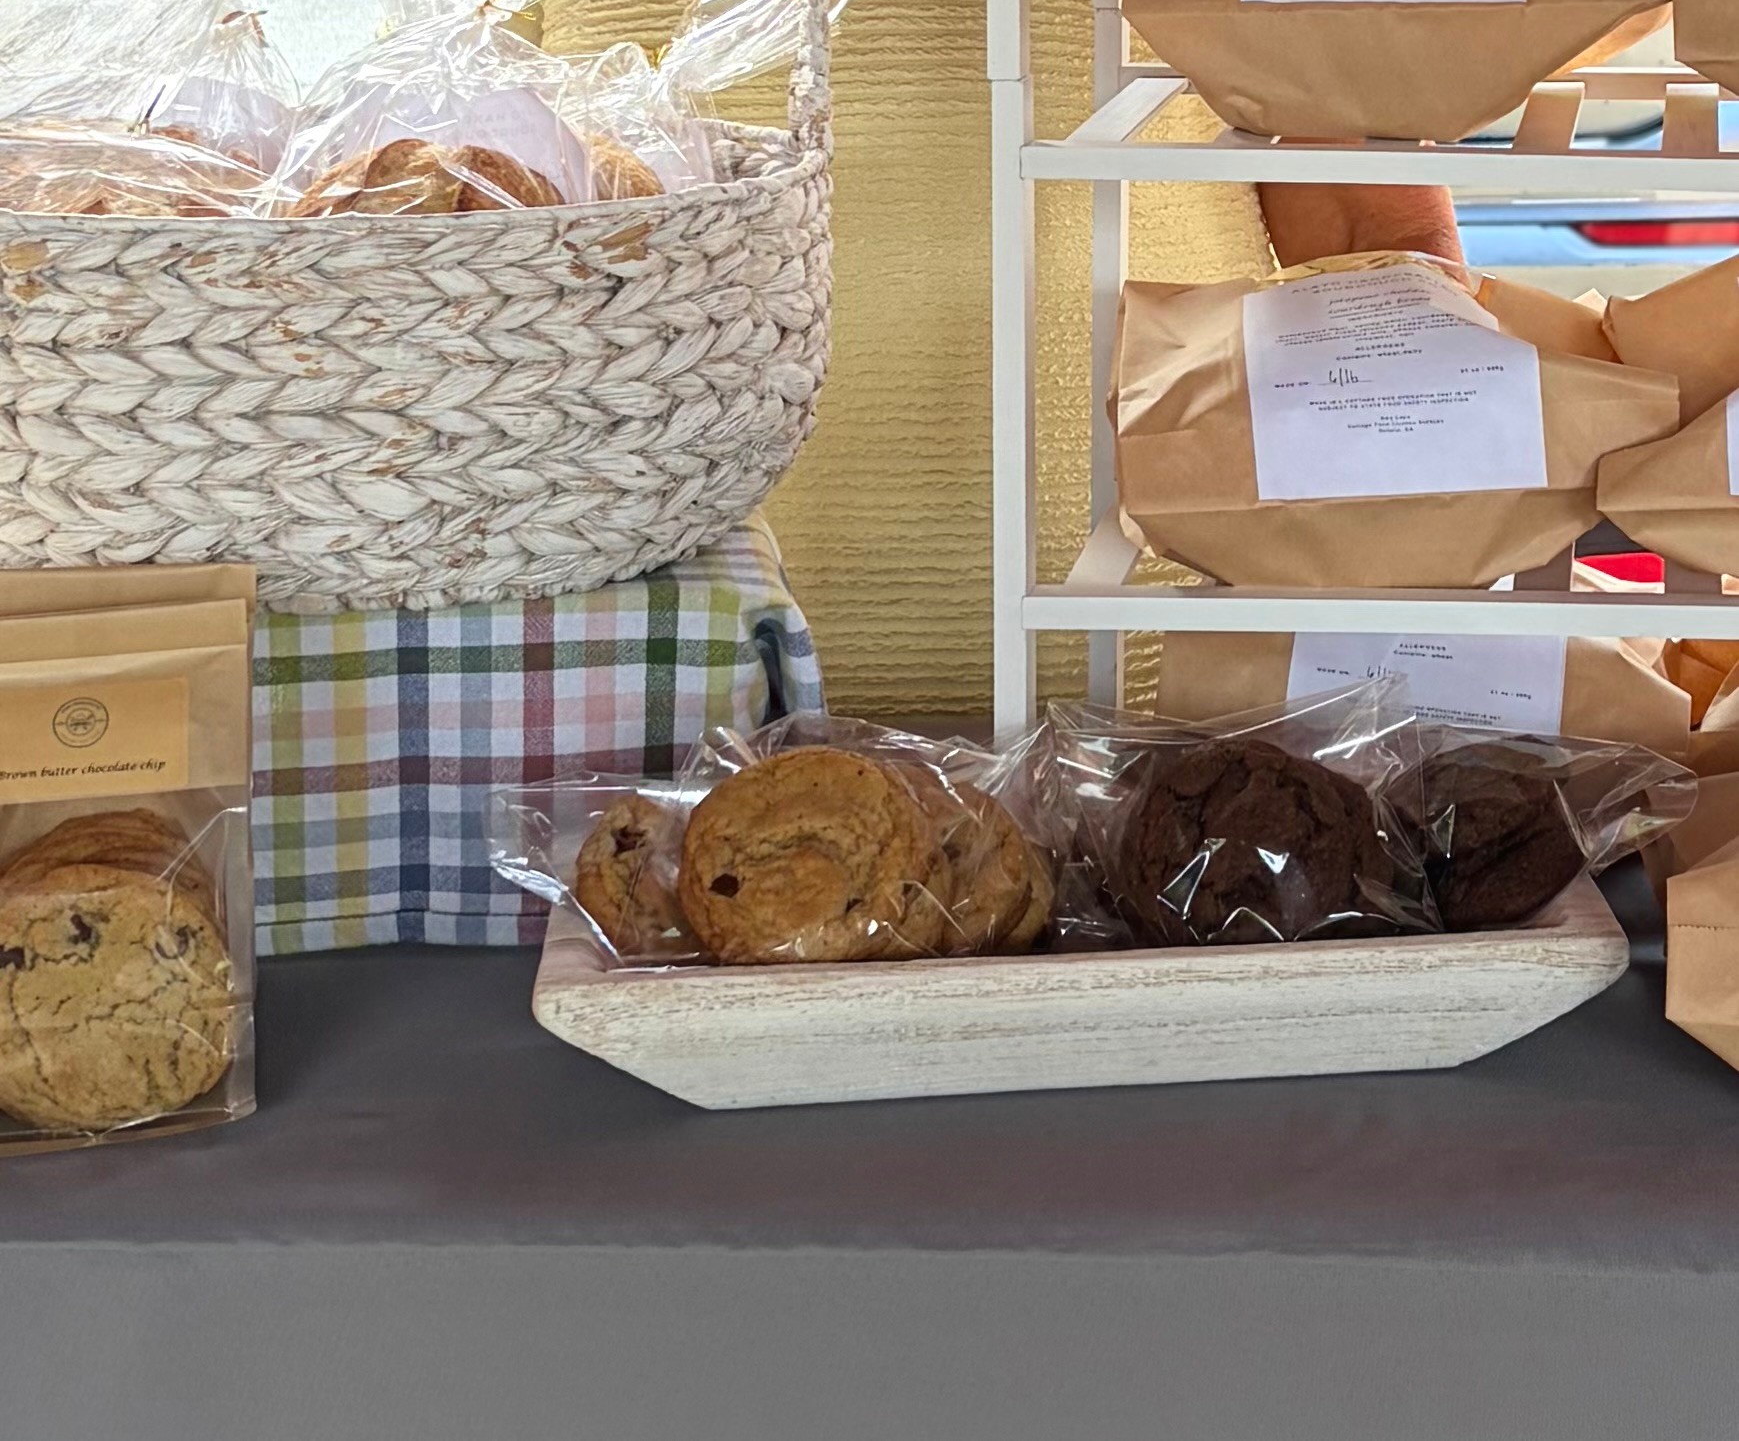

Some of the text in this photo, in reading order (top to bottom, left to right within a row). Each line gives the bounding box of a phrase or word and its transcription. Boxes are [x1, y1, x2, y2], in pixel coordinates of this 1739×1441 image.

[1327, 367, 1360, 387] 6/16
[40, 765, 79, 778] butter
[81, 760, 139, 775] chocolate
[139, 757, 167, 772] chip
